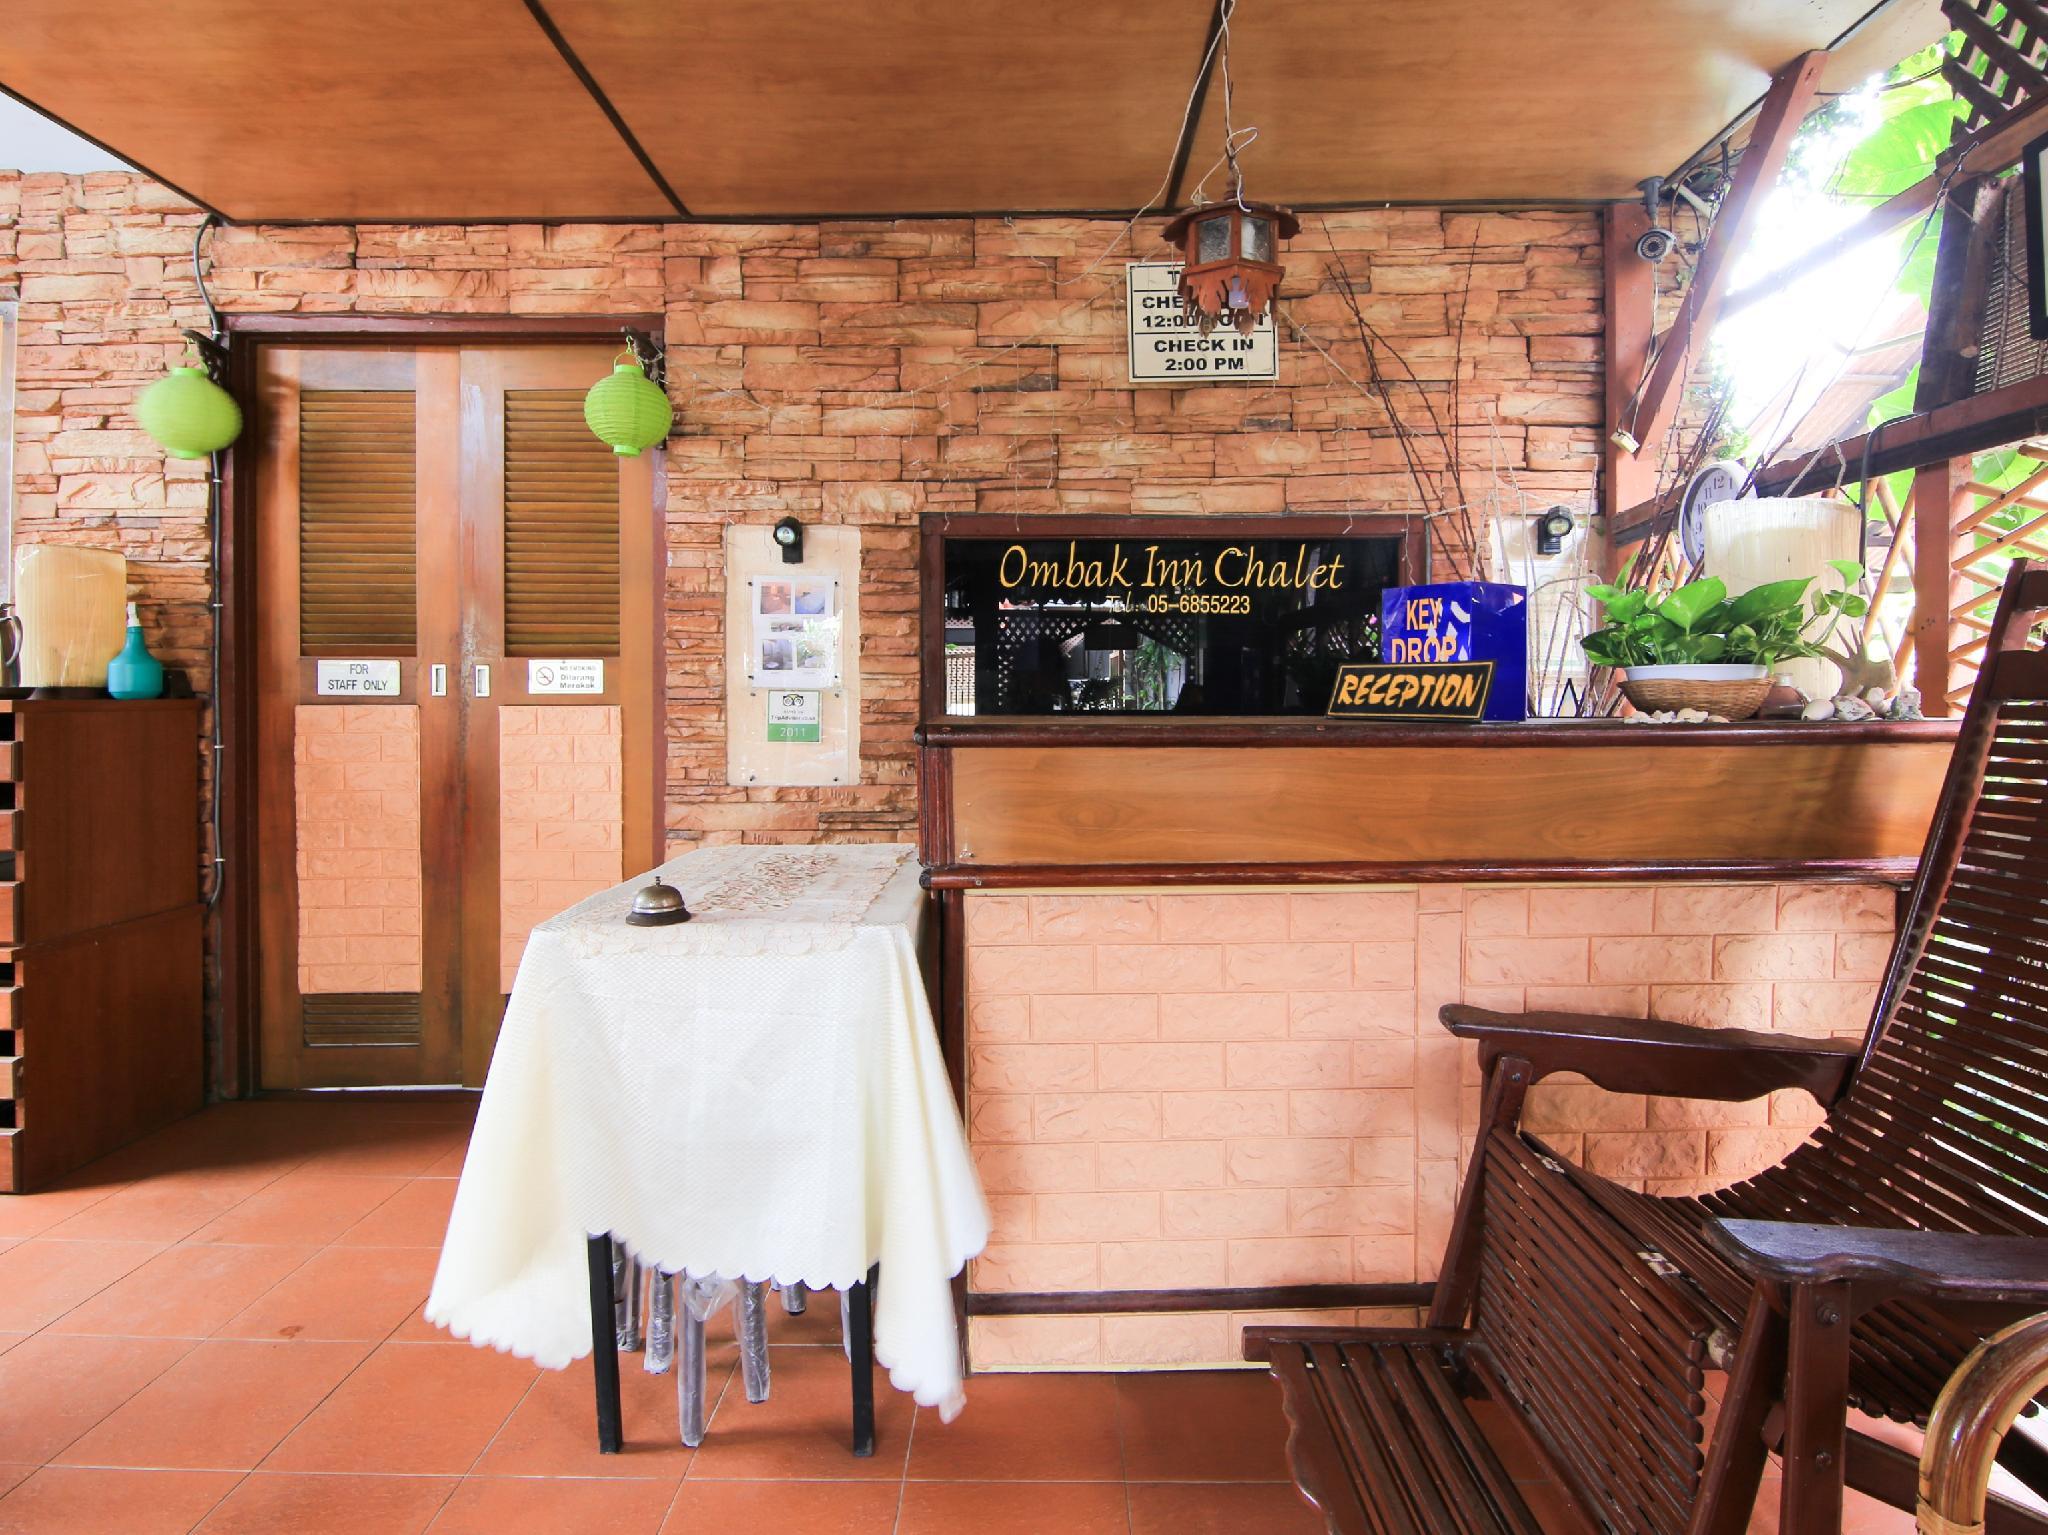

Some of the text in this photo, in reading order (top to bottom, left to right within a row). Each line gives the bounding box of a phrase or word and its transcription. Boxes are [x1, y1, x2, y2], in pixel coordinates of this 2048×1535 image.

[1142, 296, 1185, 309] CHE
[1154, 338, 1254, 353] CHECK IN
[1165, 357, 1244, 371] 2:00 PM
[1713, 475, 1725, 490] 12
[1704, 487, 1712, 499] 11
[999, 540, 1345, 589] Ombak Inn Chalet
[1148, 595, 1250, 614] 05-6855223
[1406, 597, 1443, 631] KEY
[1391, 635, 1457, 664] DROP
[349, 663, 369, 675] FOR
[328, 679, 388, 691] STAFF ONLY
[1337, 673, 1484, 708] RECEPTION
[780, 727, 805, 737] 2011
